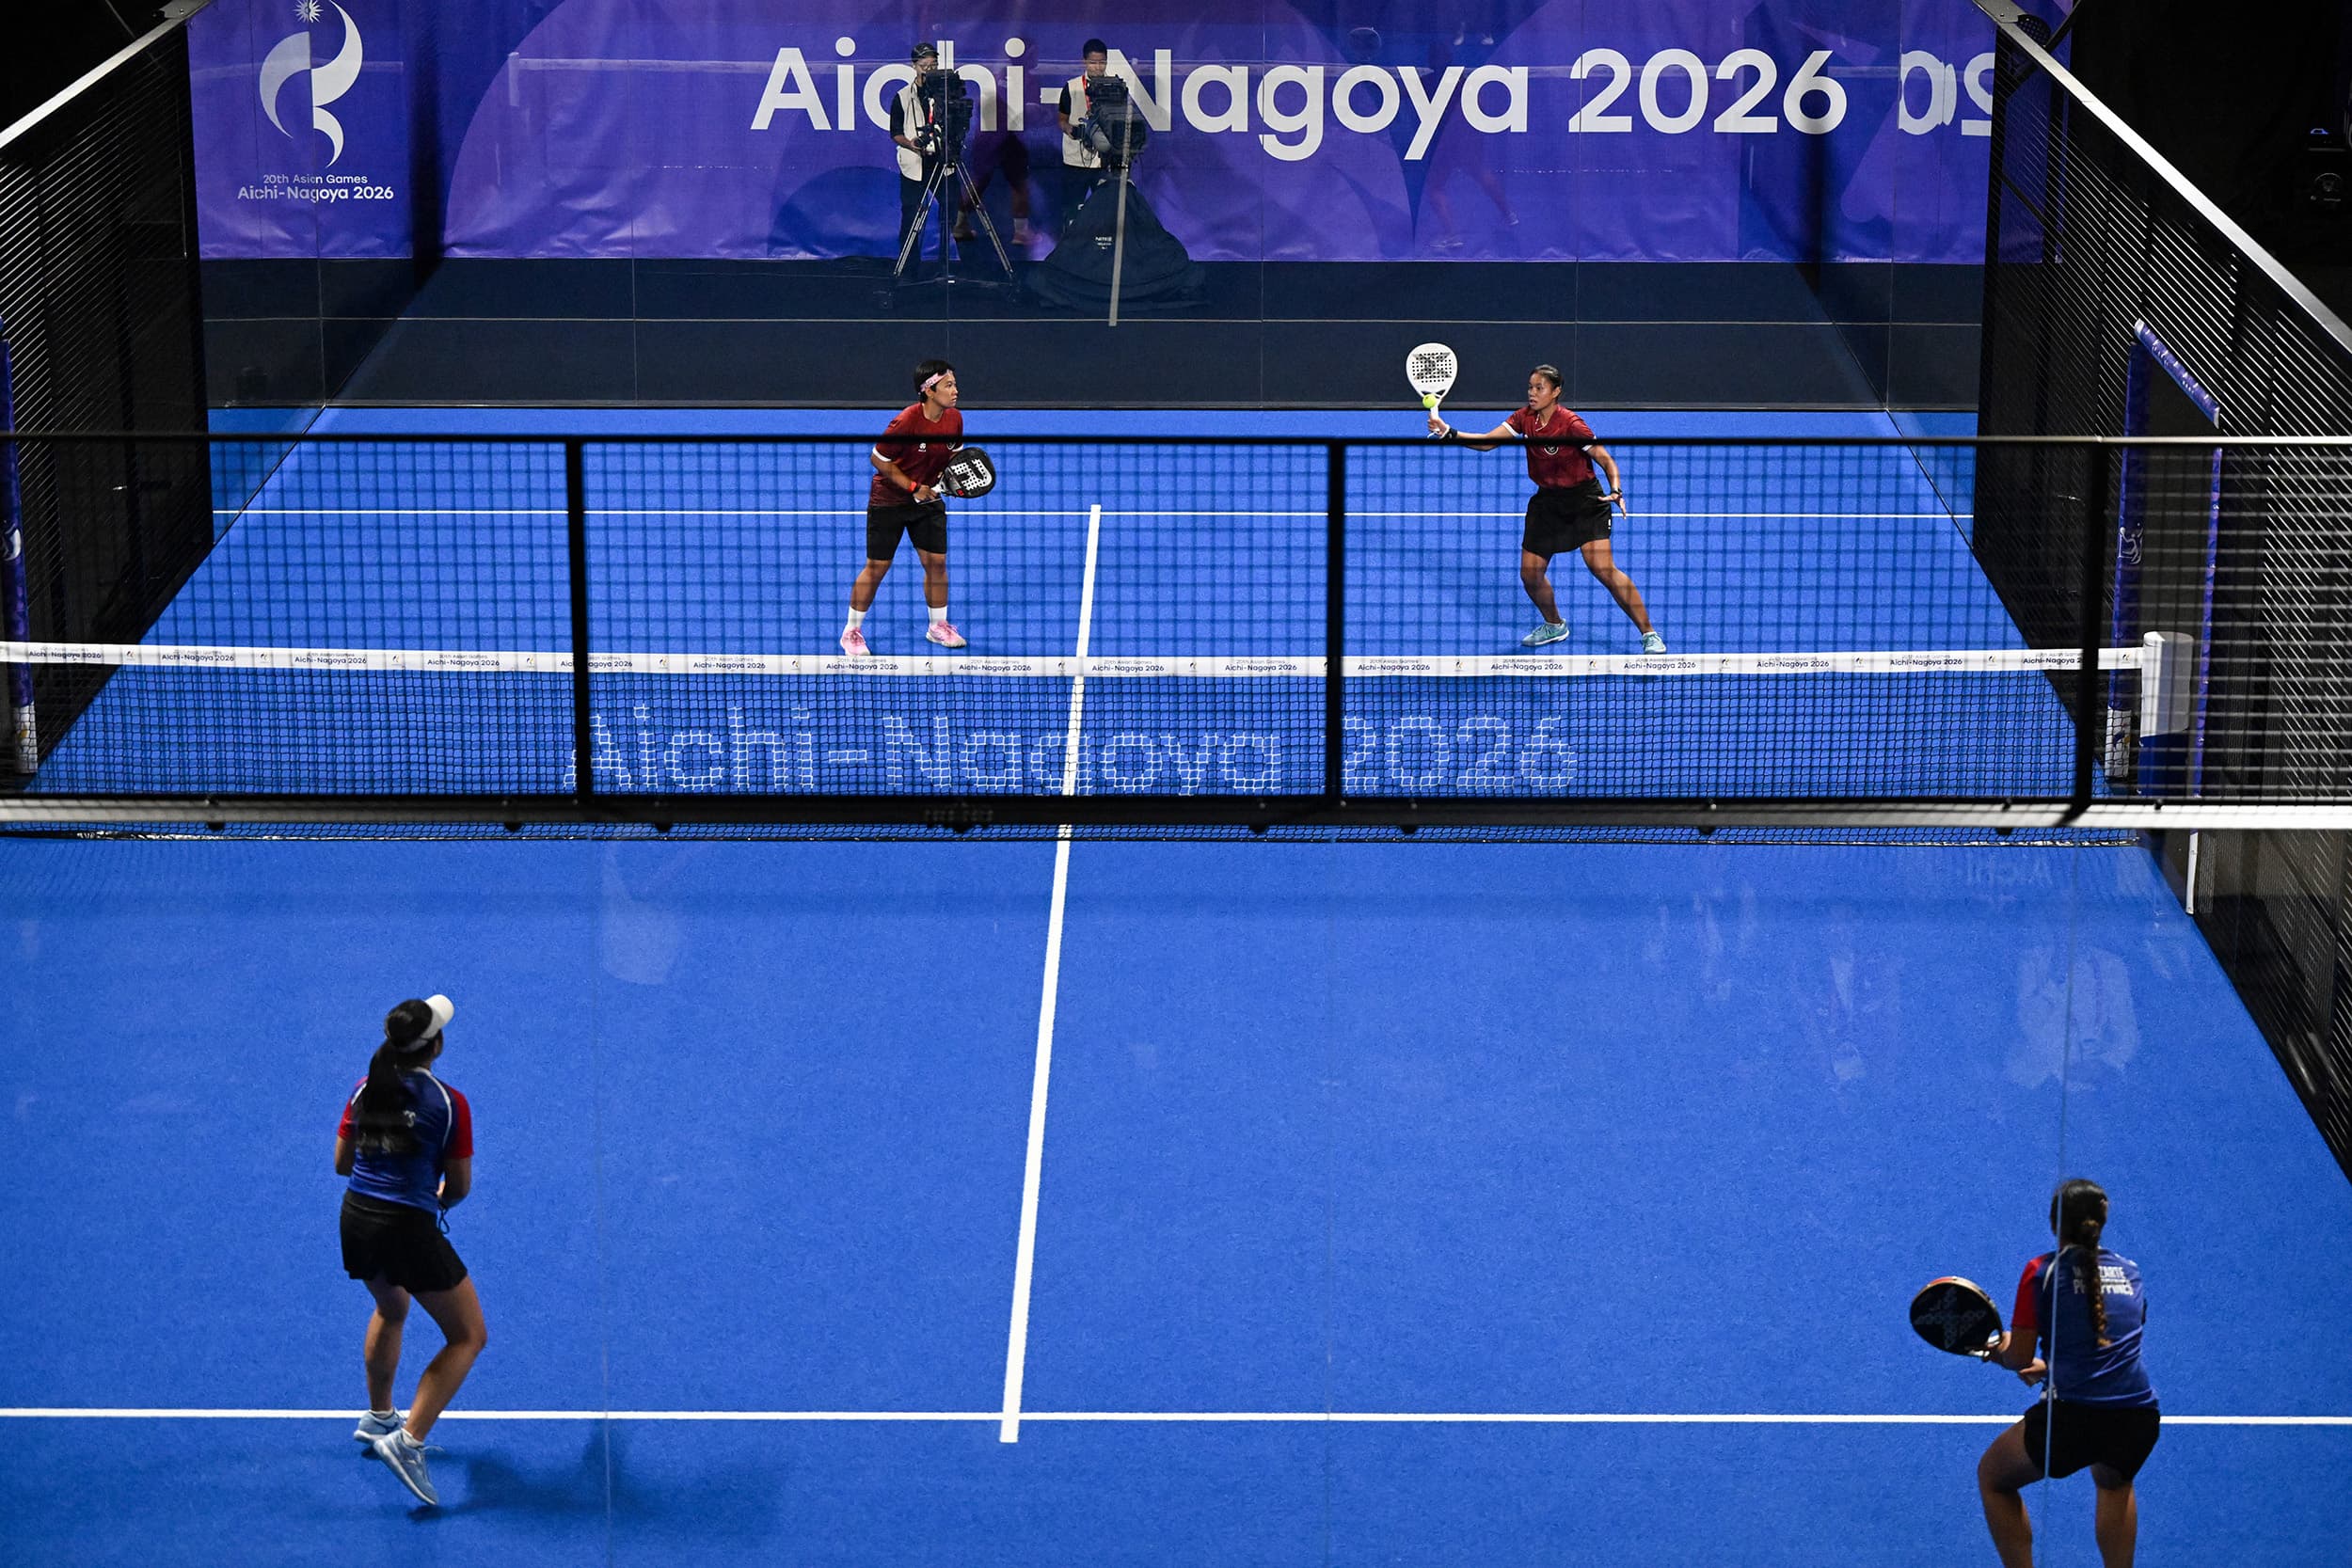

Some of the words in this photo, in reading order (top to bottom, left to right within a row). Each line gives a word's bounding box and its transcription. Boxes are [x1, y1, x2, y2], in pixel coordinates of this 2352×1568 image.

[751, 36, 1528, 161] Aichi-Nagoya
[1568, 48, 1847, 135] 2026
[263, 174, 289, 183] 20th
[294, 174, 323, 183] Asian
[326, 174, 368, 183] Games
[237, 185, 349, 203] Aichi-Nagoya
[353, 186, 393, 199] 2026
[294, 657, 346, 665] Aichi-Nagoya
[1321, 714, 1578, 790] 2026
